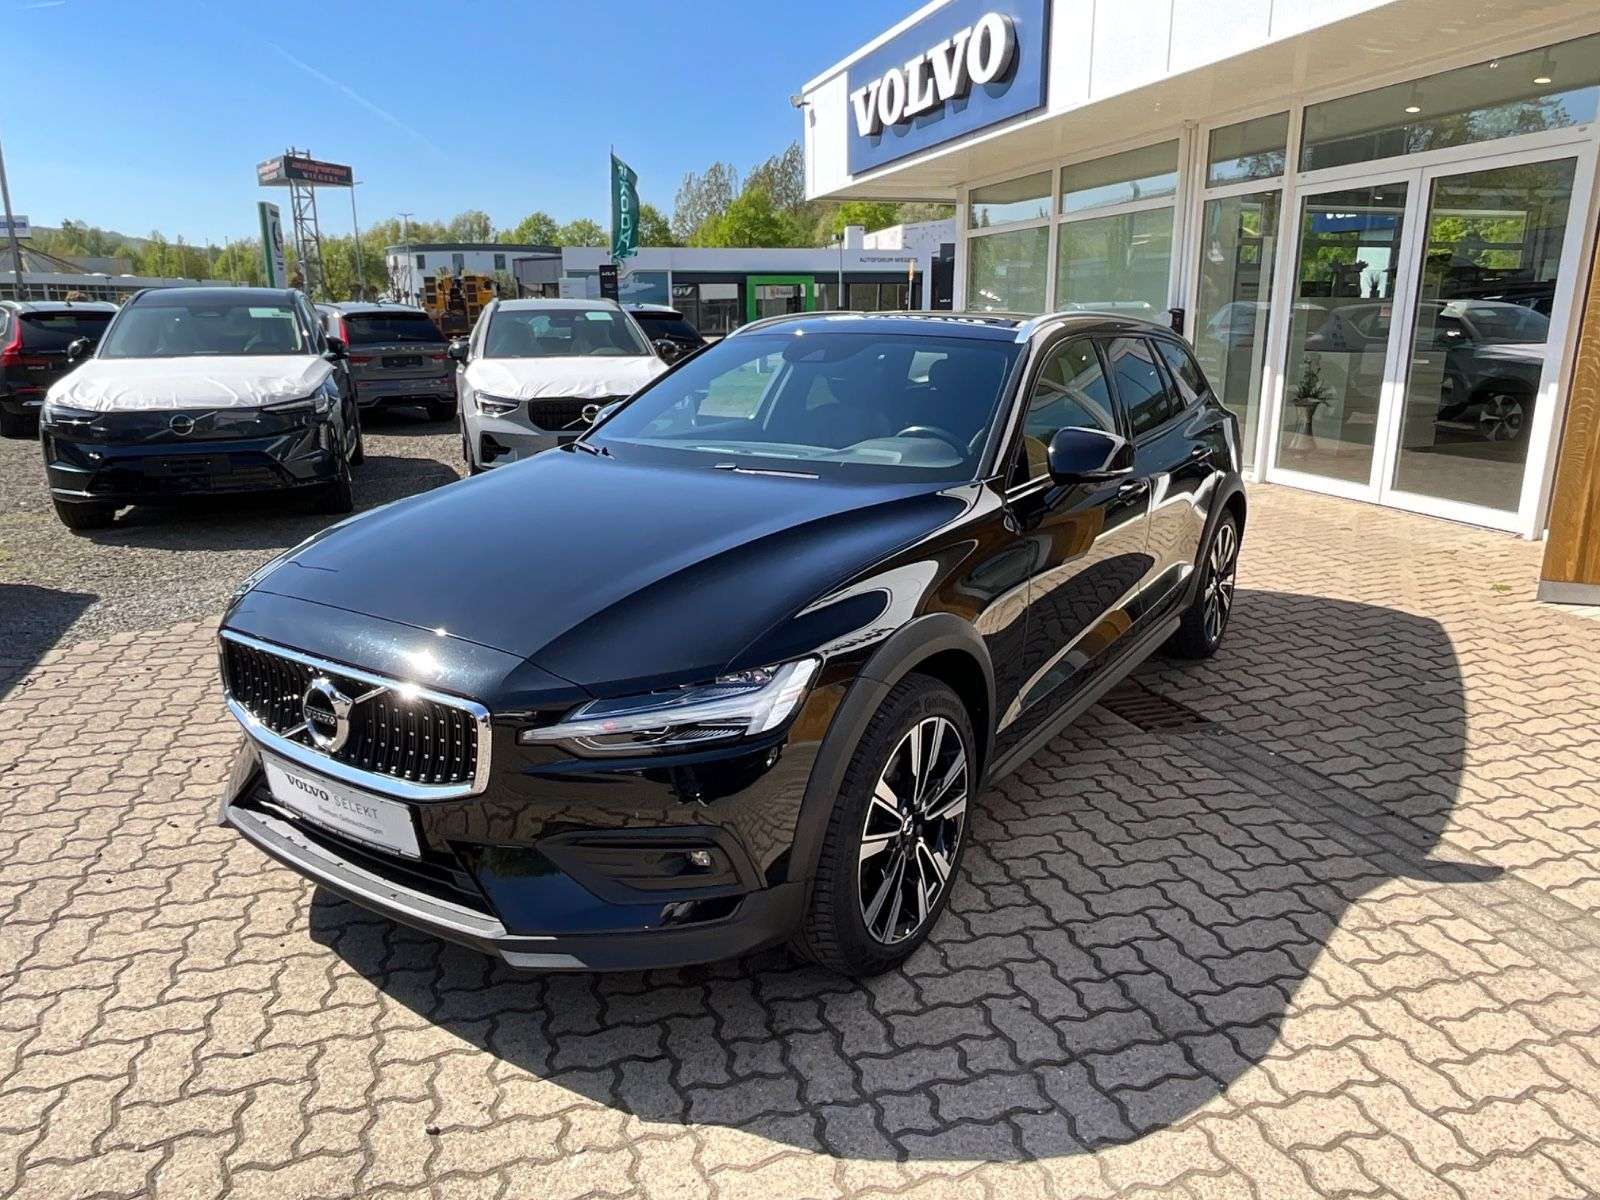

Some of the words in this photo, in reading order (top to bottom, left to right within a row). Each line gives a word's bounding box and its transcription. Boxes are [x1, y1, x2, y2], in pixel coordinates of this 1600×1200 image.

[850, 12, 1014, 137] VOLVO
[285, 773, 330, 802] VOLVO
[333, 794, 379, 819] SELEKT
